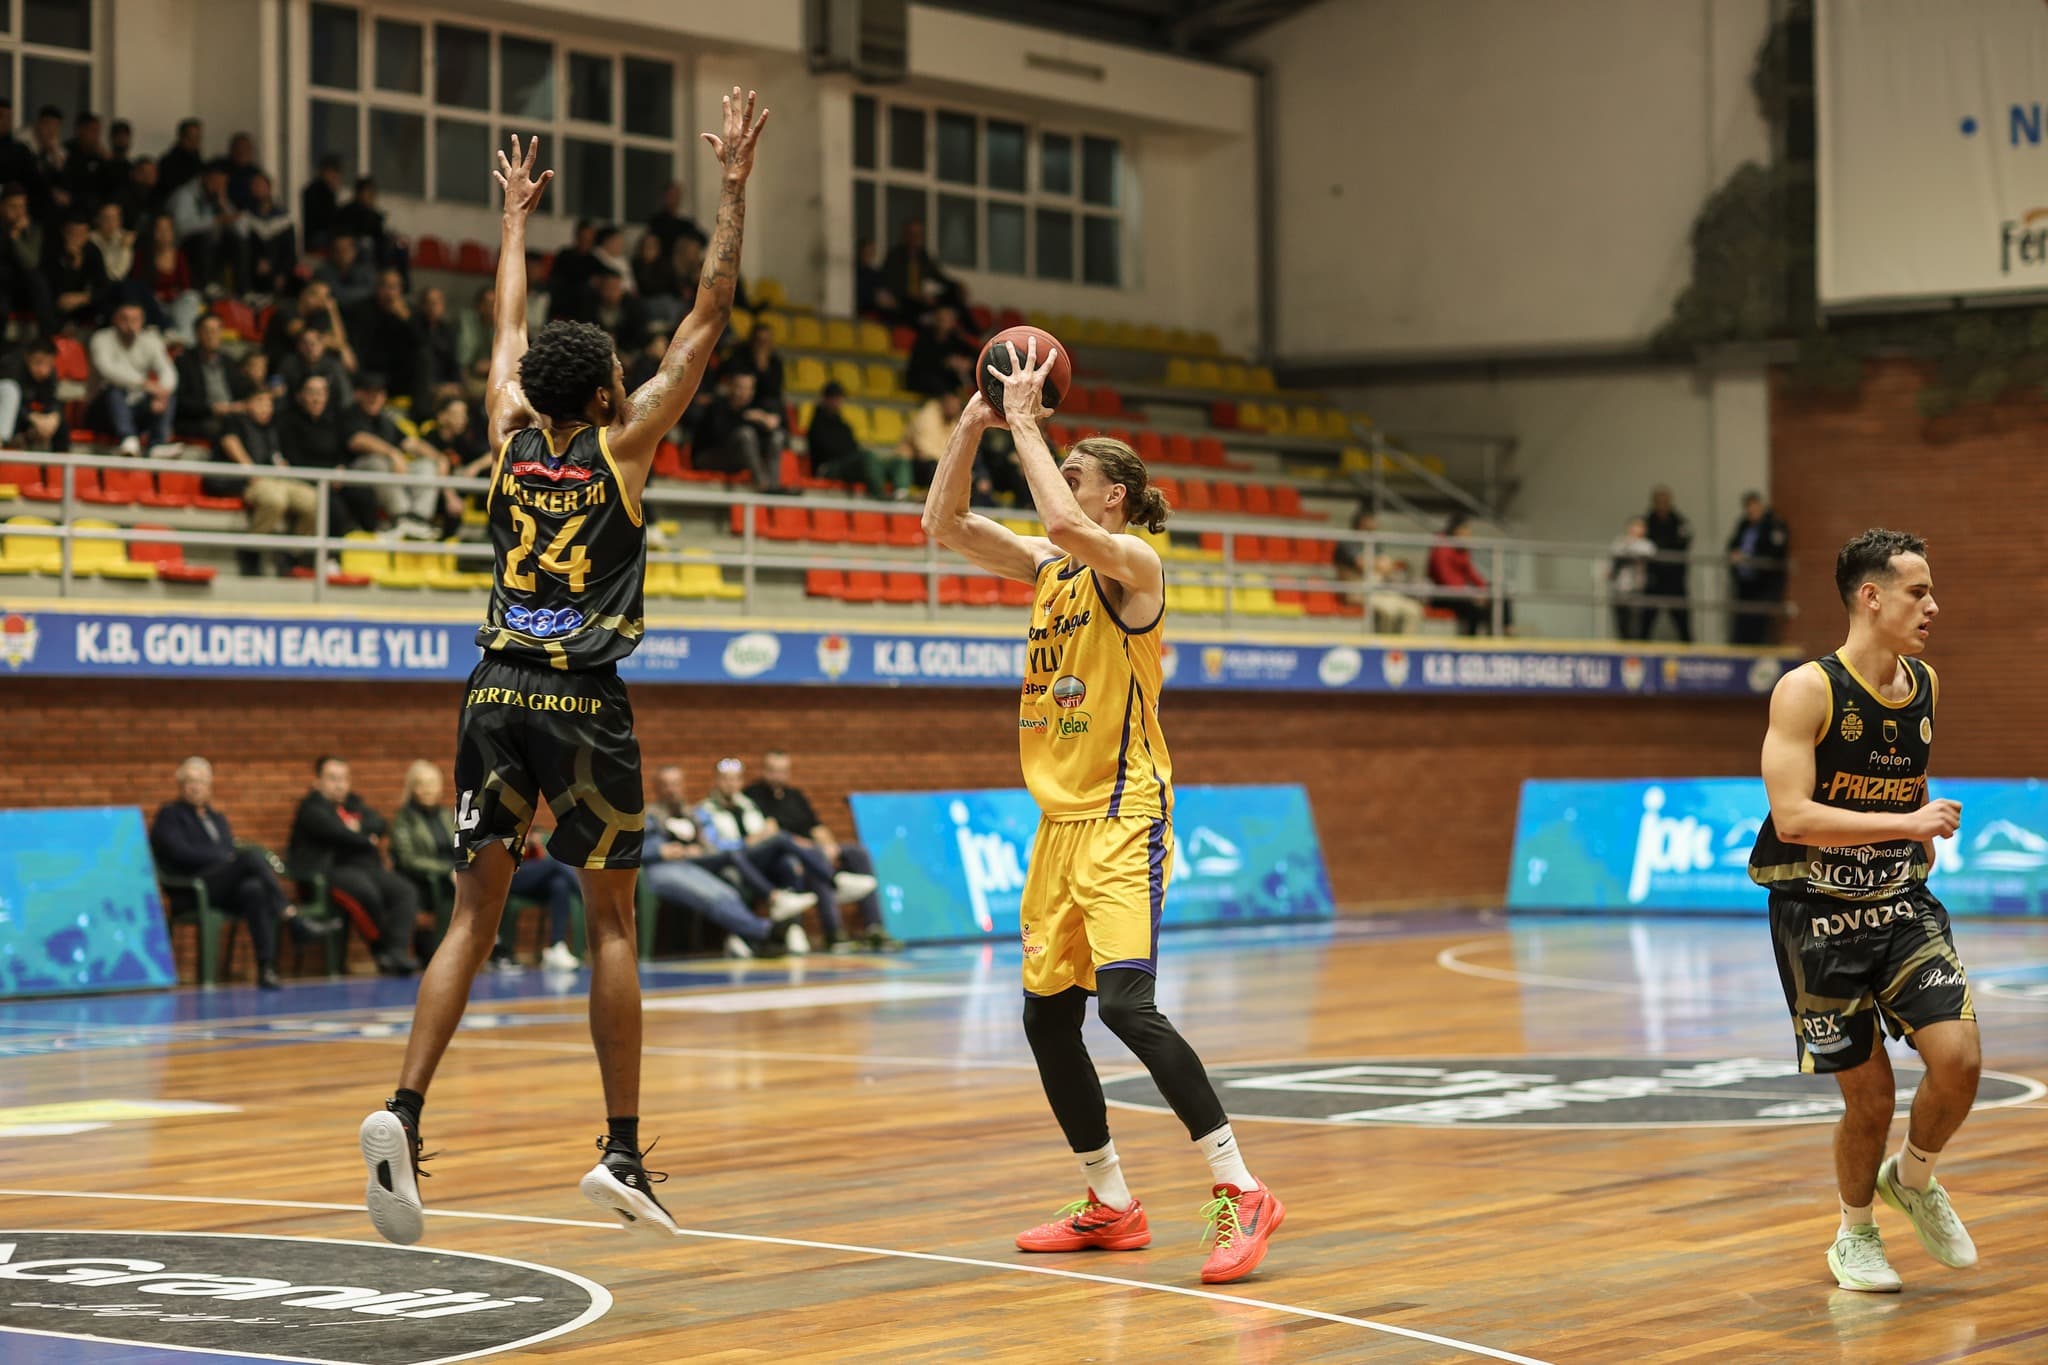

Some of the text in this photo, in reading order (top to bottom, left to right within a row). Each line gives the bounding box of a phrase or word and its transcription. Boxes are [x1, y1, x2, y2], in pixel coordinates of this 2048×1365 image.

[503, 504, 592, 593] 24
[75, 621, 449, 669] K.B. GOLDEN EAGLE YLLI
[873, 640, 918, 675] K.B.
[920, 641, 1010, 677] GOLDEN
[528, 693, 602, 715] GROUP
[1869, 747, 1911, 766] Proton
